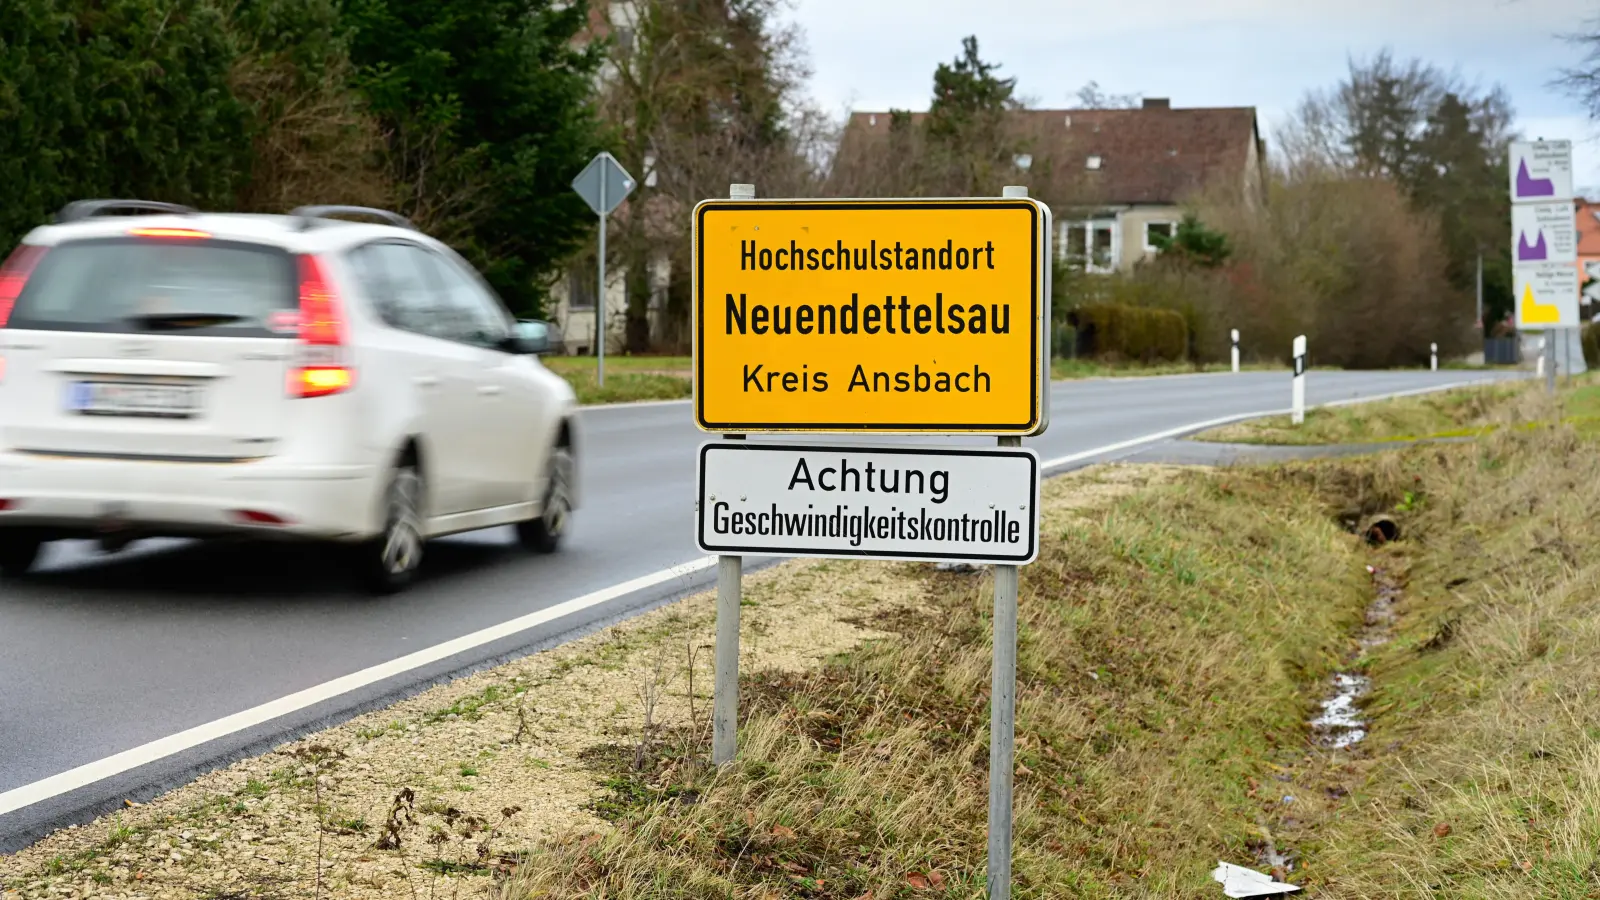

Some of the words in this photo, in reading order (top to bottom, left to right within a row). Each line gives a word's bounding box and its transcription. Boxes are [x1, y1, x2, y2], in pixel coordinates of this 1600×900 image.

[742, 240, 994, 270] Hochschulstandort
[726, 293, 1009, 334] Neuendettelsau
[744, 365, 828, 392] Kreis
[848, 365, 990, 392] Ansbach
[788, 457, 950, 503] Achtung
[713, 502, 1020, 547] Geschwindigkeitskontrolle
